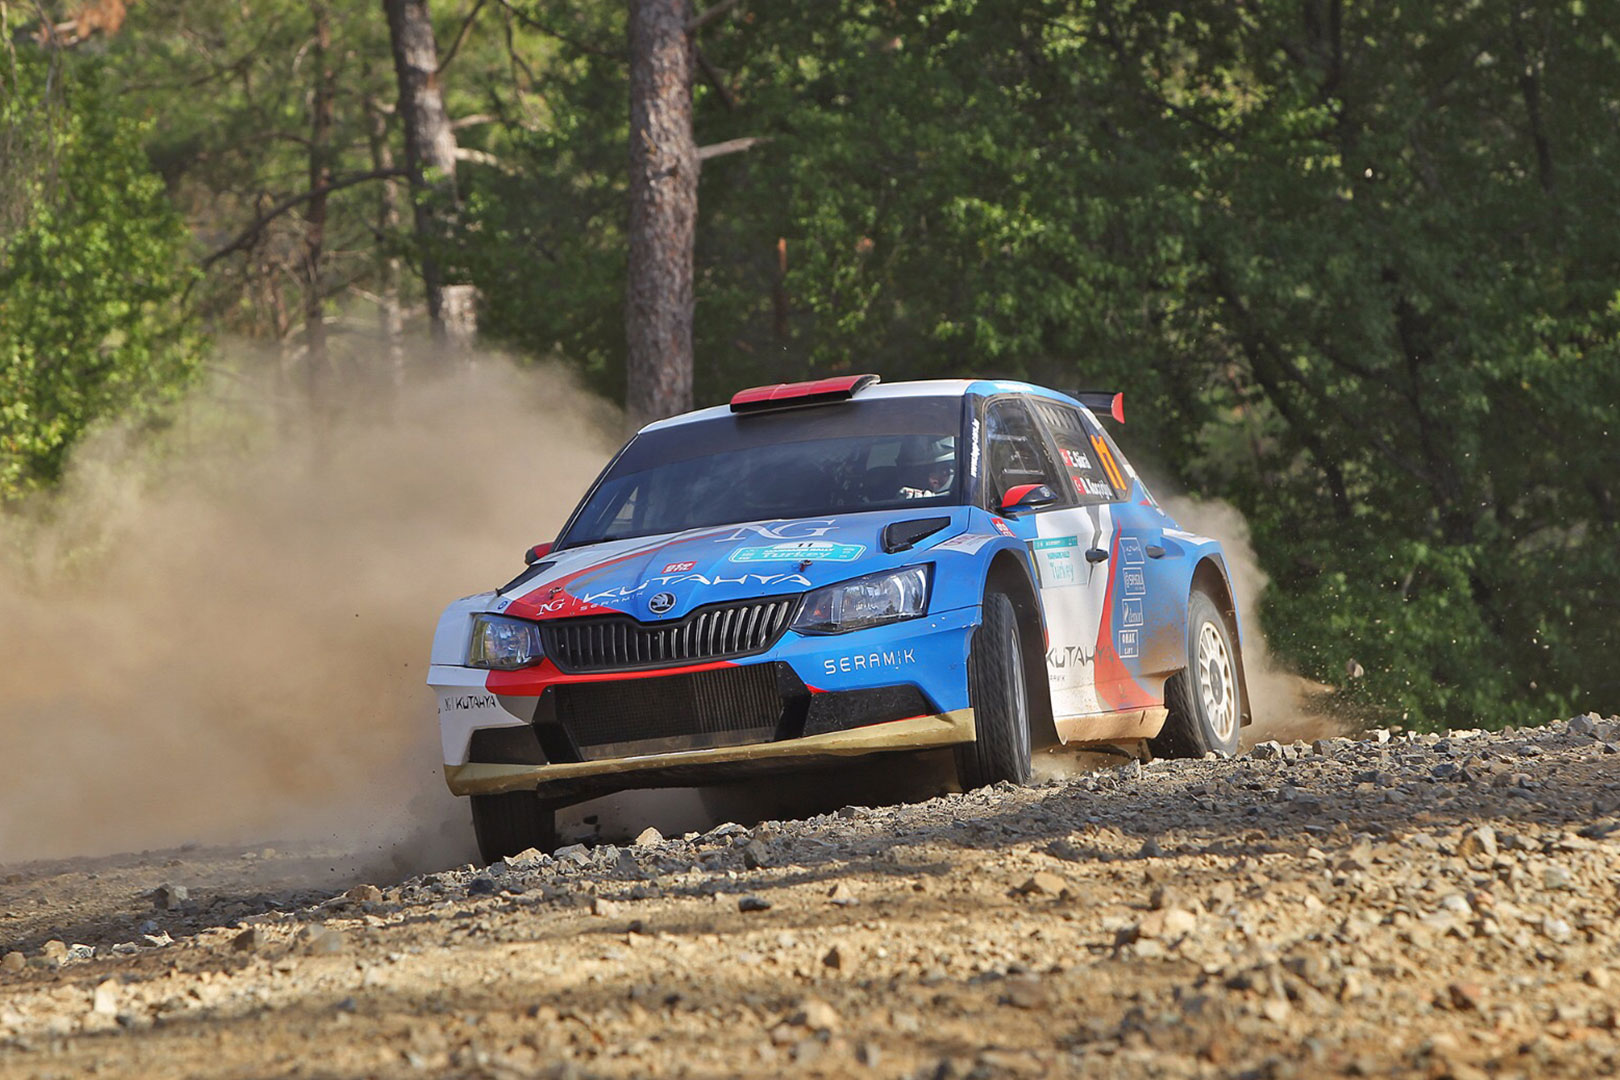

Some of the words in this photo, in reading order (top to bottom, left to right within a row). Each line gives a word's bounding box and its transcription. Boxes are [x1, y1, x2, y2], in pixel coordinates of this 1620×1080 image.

[1090, 434, 1127, 491] 11
[714, 519, 840, 543] NG
[762, 551, 831, 559] Turkey
[1049, 560, 1074, 583] Turkey
[536, 598, 565, 616] NG
